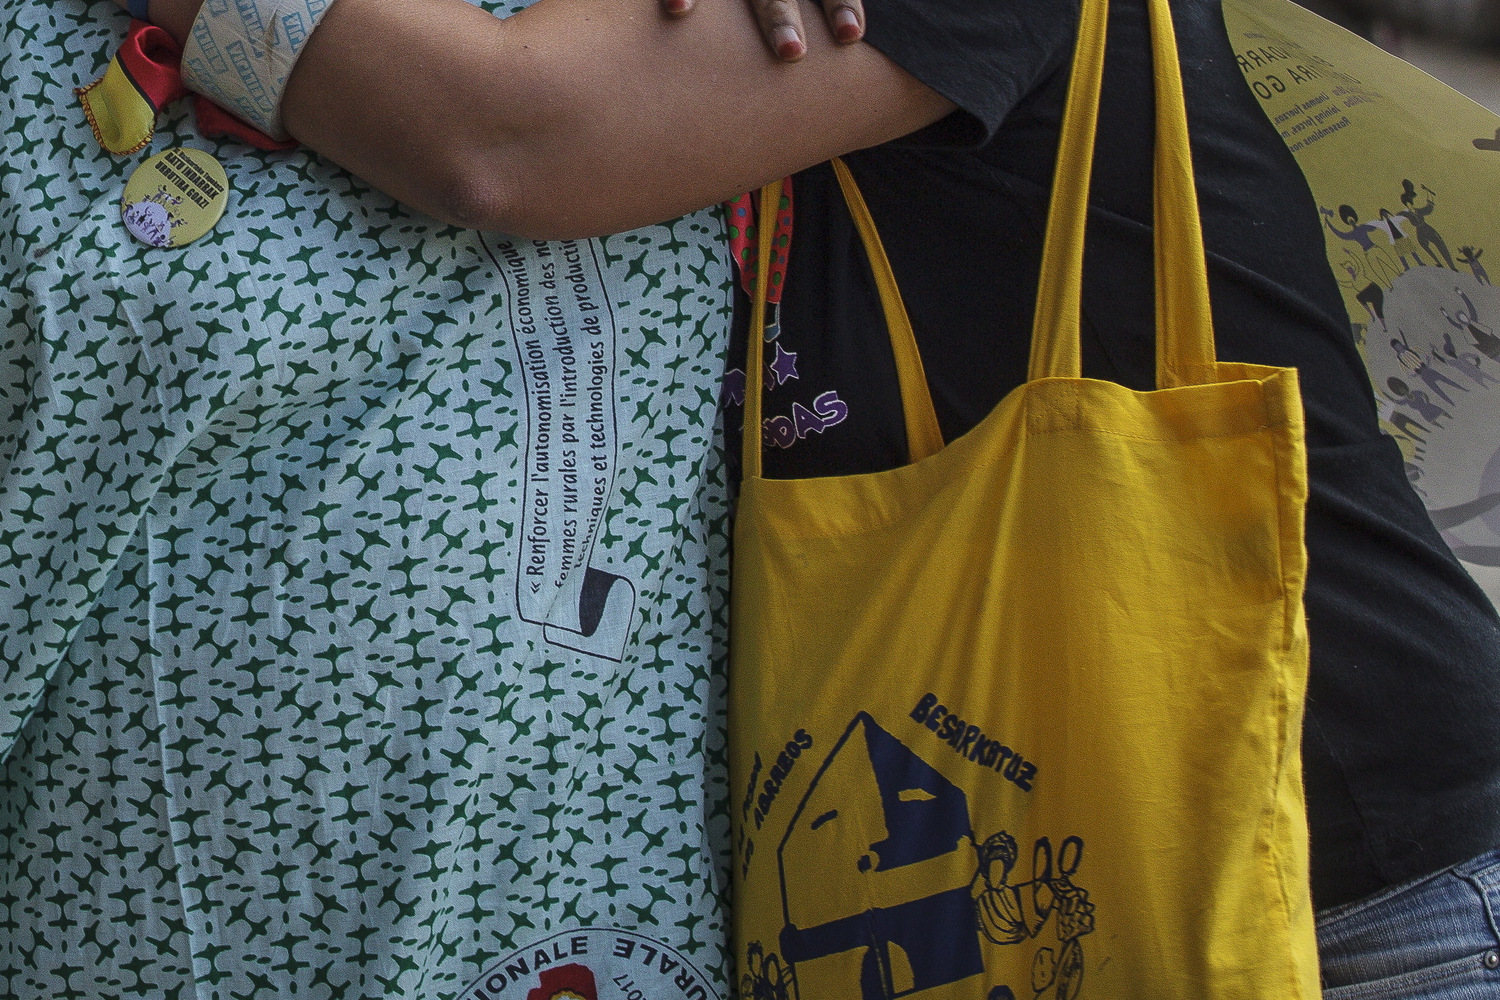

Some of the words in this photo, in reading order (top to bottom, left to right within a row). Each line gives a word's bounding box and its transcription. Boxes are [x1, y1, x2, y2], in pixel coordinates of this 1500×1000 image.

[155, 161, 190, 194] URRUTIRA
[164, 152, 185, 171] BATU
[181, 166, 219, 201] INDARRAK
[497, 240, 536, 335] économique
[539, 262, 557, 290] des
[544, 295, 578, 407] l'introduction
[581, 316, 602, 336] de
[524, 338, 551, 482] l'autonomisation
[586, 341, 608, 450] technologies
[562, 413, 580, 444] par
[558, 449, 578, 513] rurales
[591, 454, 608, 472] et
[526, 488, 550, 576] Renforcer
[554, 519, 577, 589] femmes
[909, 692, 1038, 792] BESARKATUZ
[466, 936, 589, 1000] IONALE
